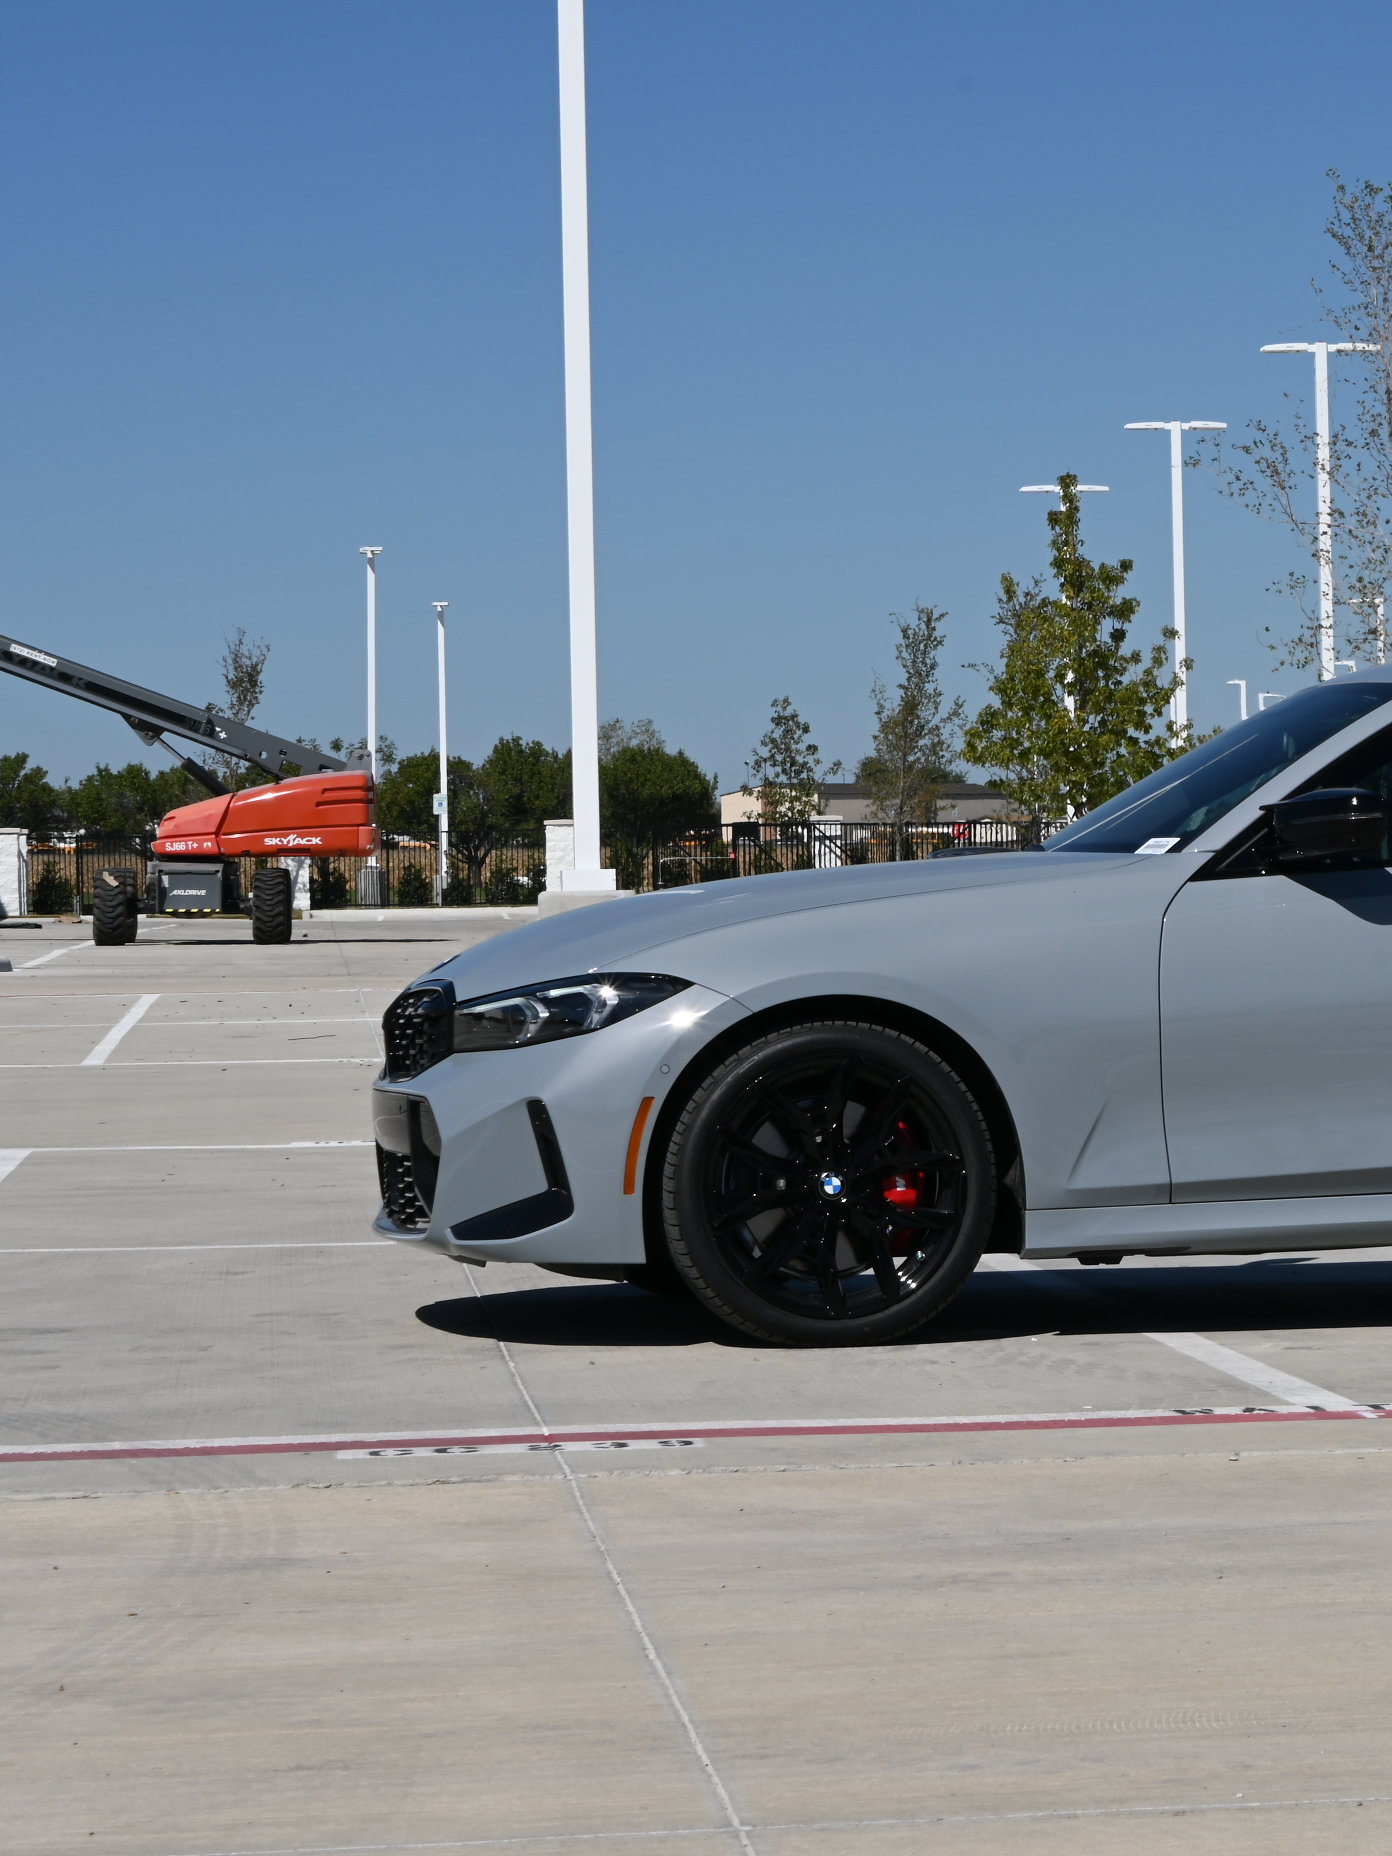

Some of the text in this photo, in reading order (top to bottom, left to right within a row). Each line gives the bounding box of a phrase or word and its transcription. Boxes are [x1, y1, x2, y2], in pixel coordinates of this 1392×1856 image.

[165, 841, 199, 851] SJ66 T+
[264, 833, 322, 847] SKYJACK
